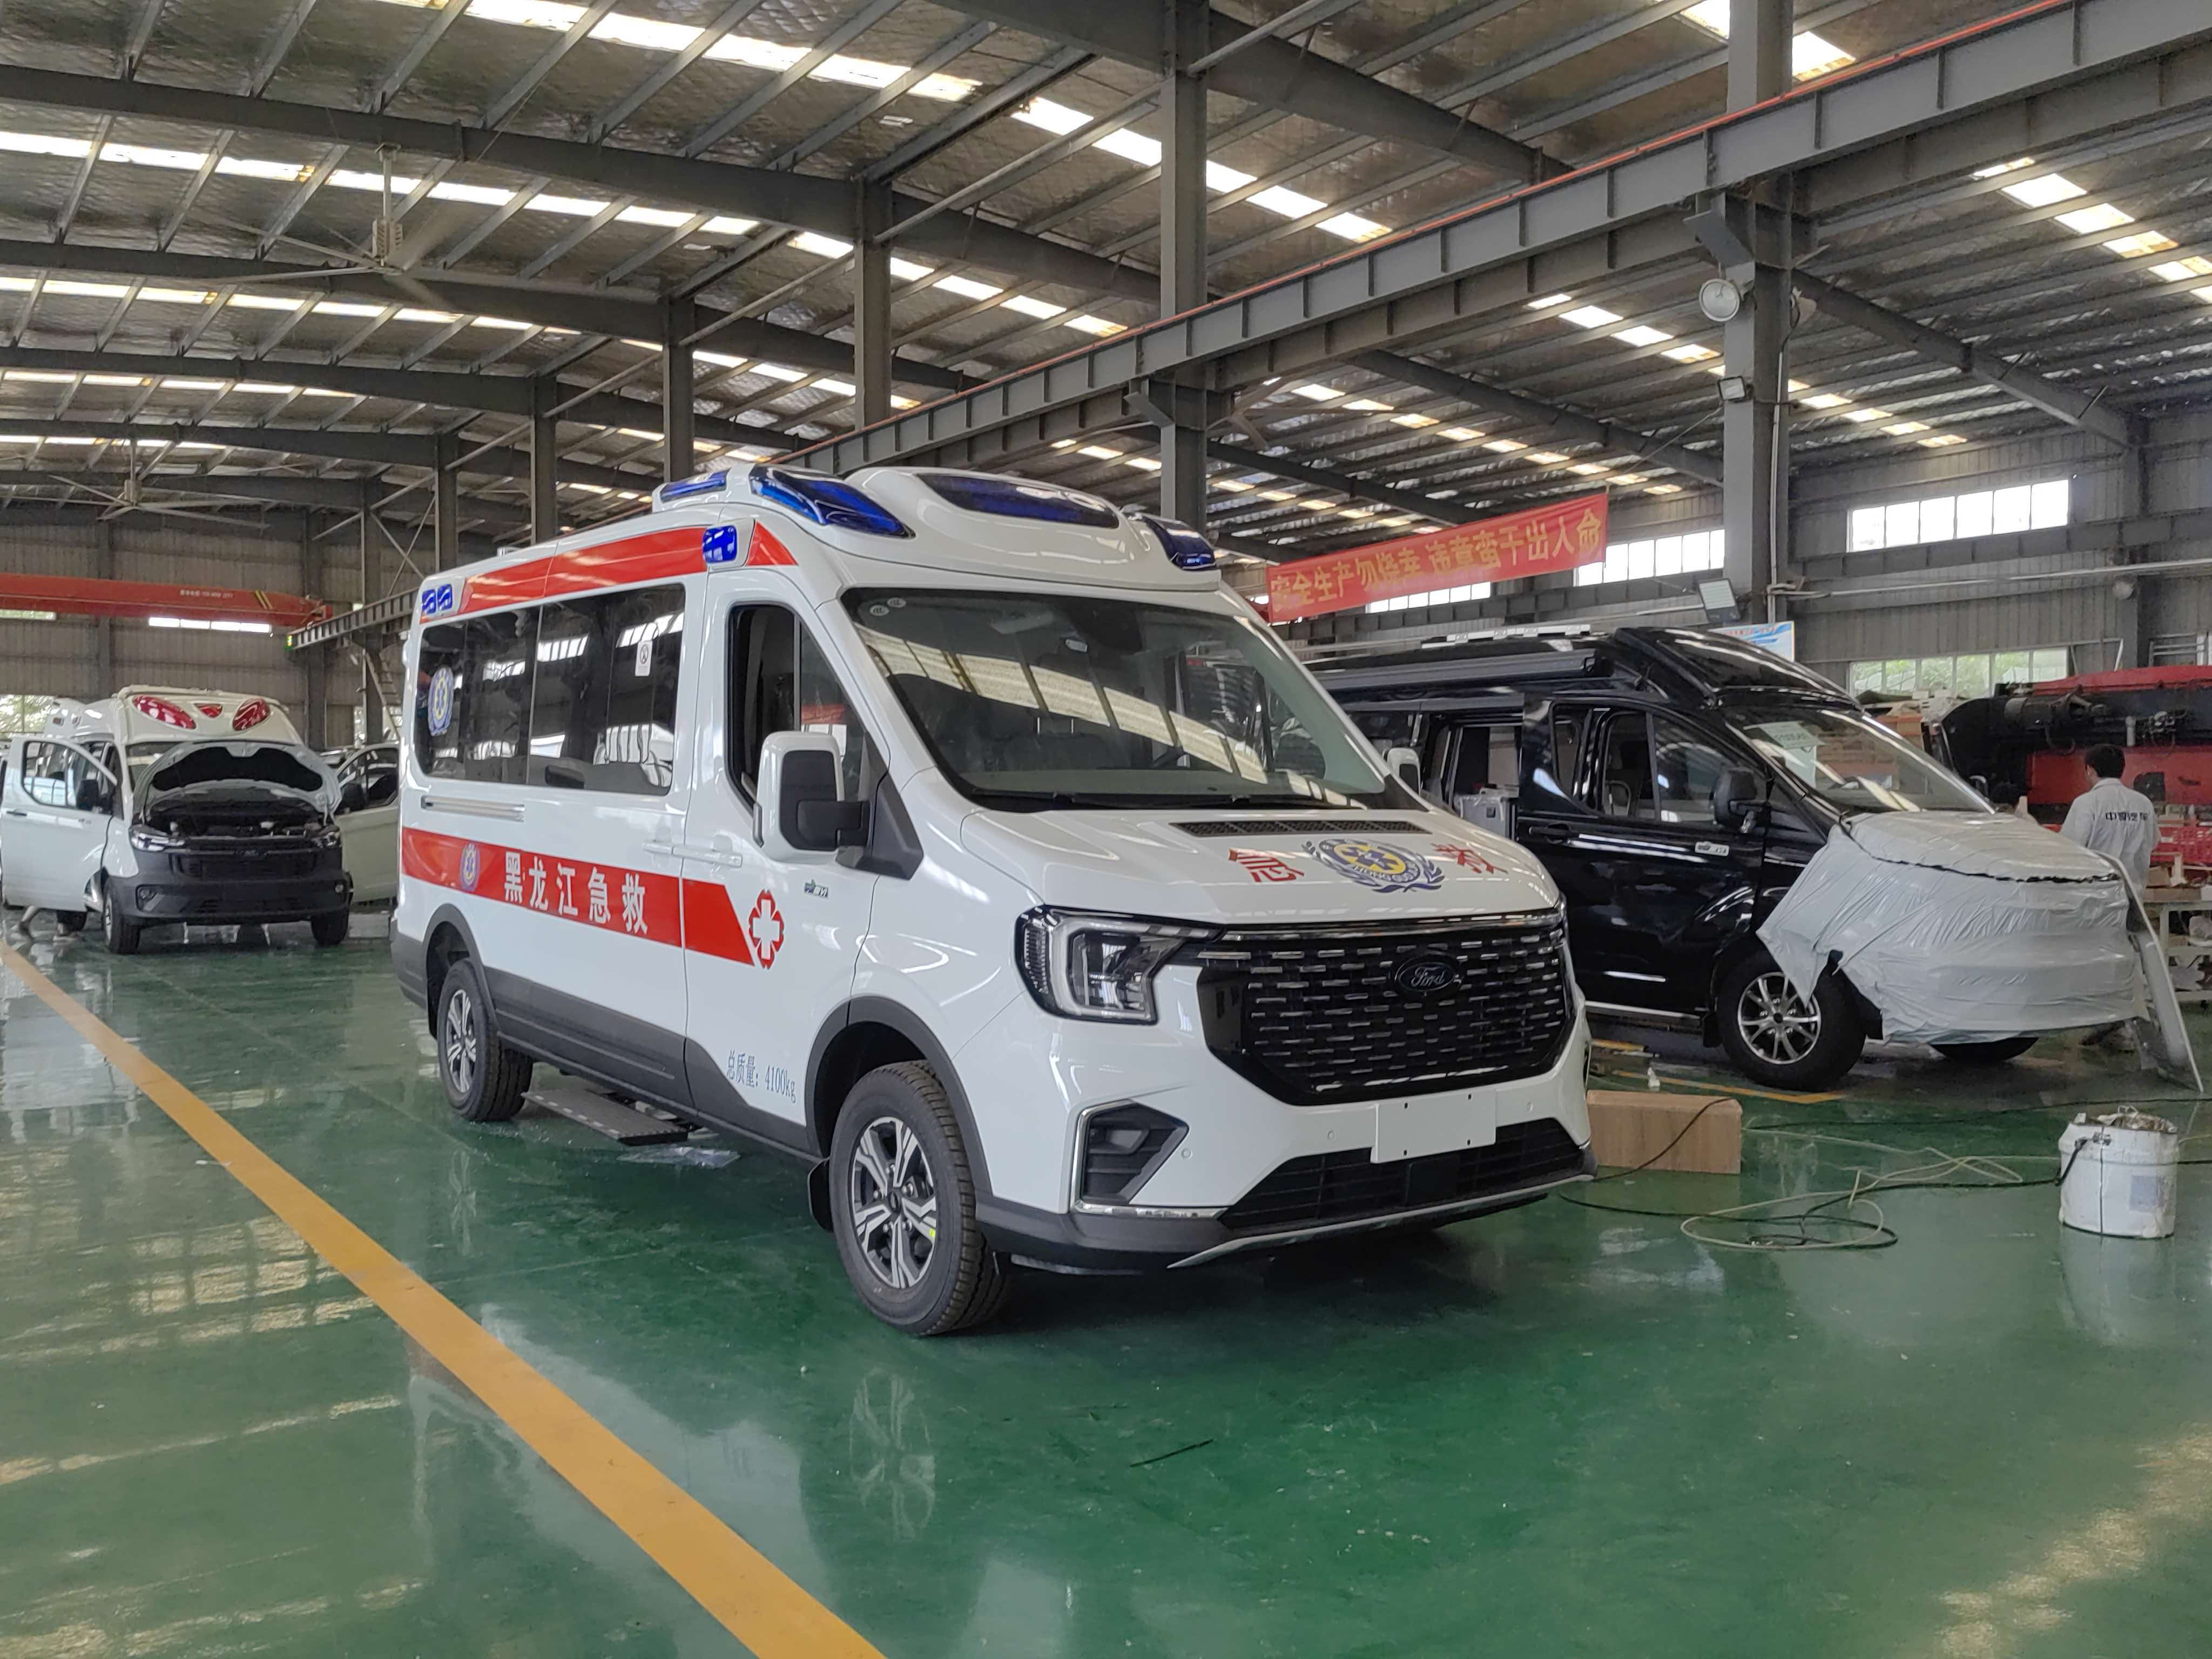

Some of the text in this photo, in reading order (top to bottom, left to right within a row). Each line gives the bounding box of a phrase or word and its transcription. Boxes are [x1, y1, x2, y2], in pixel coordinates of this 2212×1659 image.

[504, 851, 648, 934] 黑龙江急救
[1411, 966, 1448, 987] Ford
[765, 1064, 797, 1104] 4100kg
